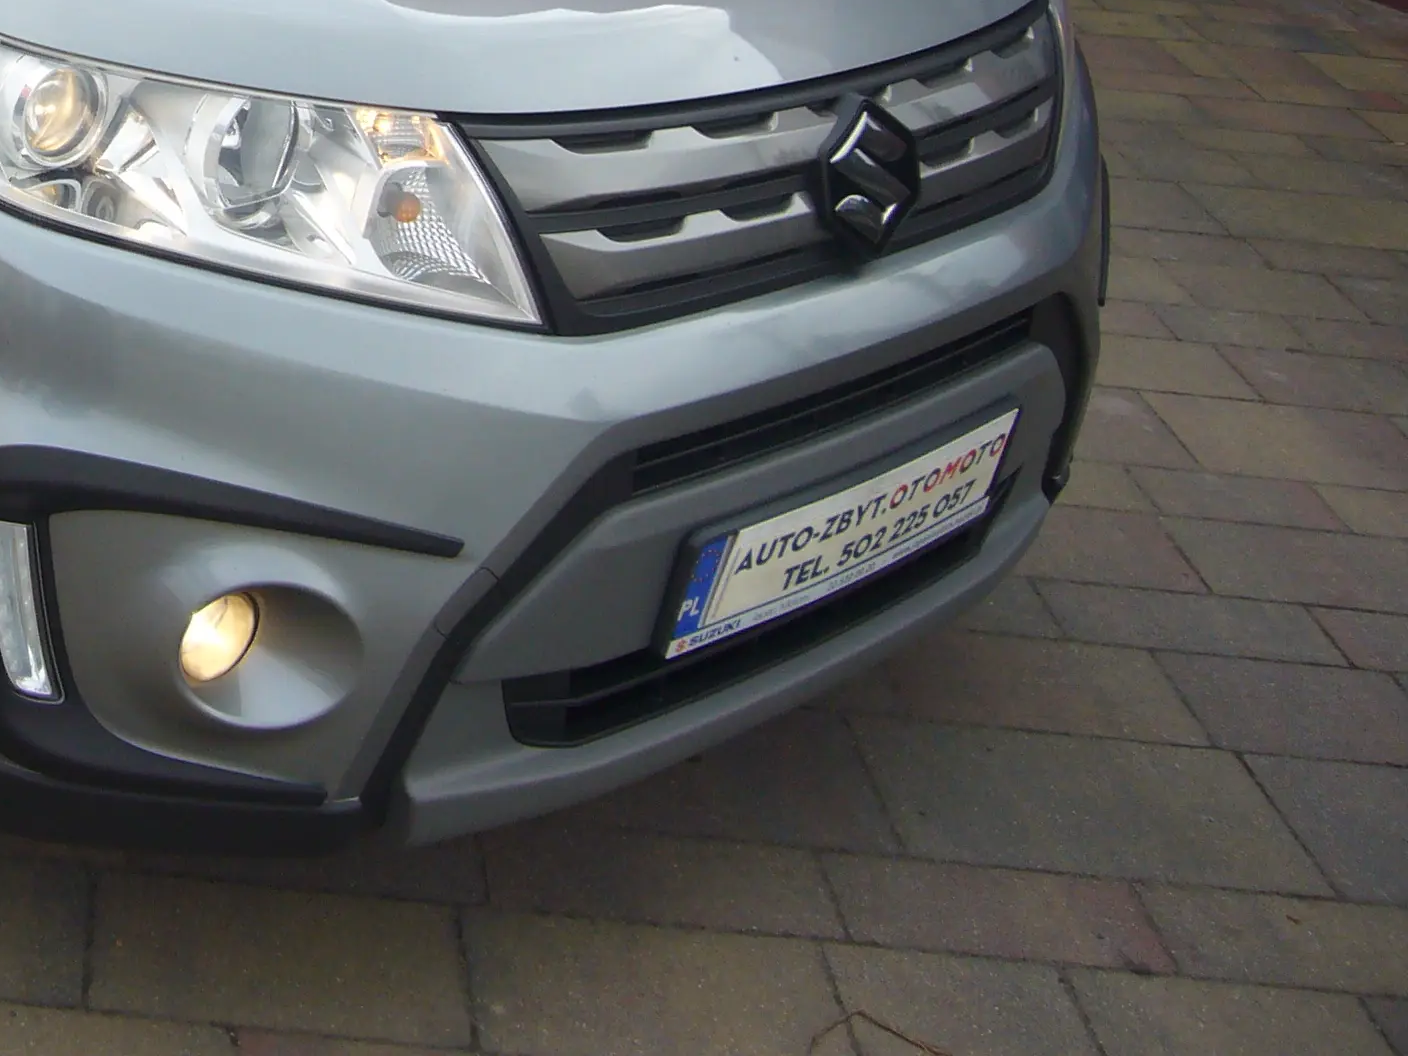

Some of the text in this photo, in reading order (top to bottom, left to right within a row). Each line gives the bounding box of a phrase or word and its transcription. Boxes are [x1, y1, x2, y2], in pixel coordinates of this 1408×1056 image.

[782, 554, 830, 591] TEL.
[836, 525, 888, 567] 502
[888, 503, 932, 543] 225
[932, 478, 977, 519] 057
[677, 595, 700, 622] PL
[687, 619, 742, 646] SUZUKI
